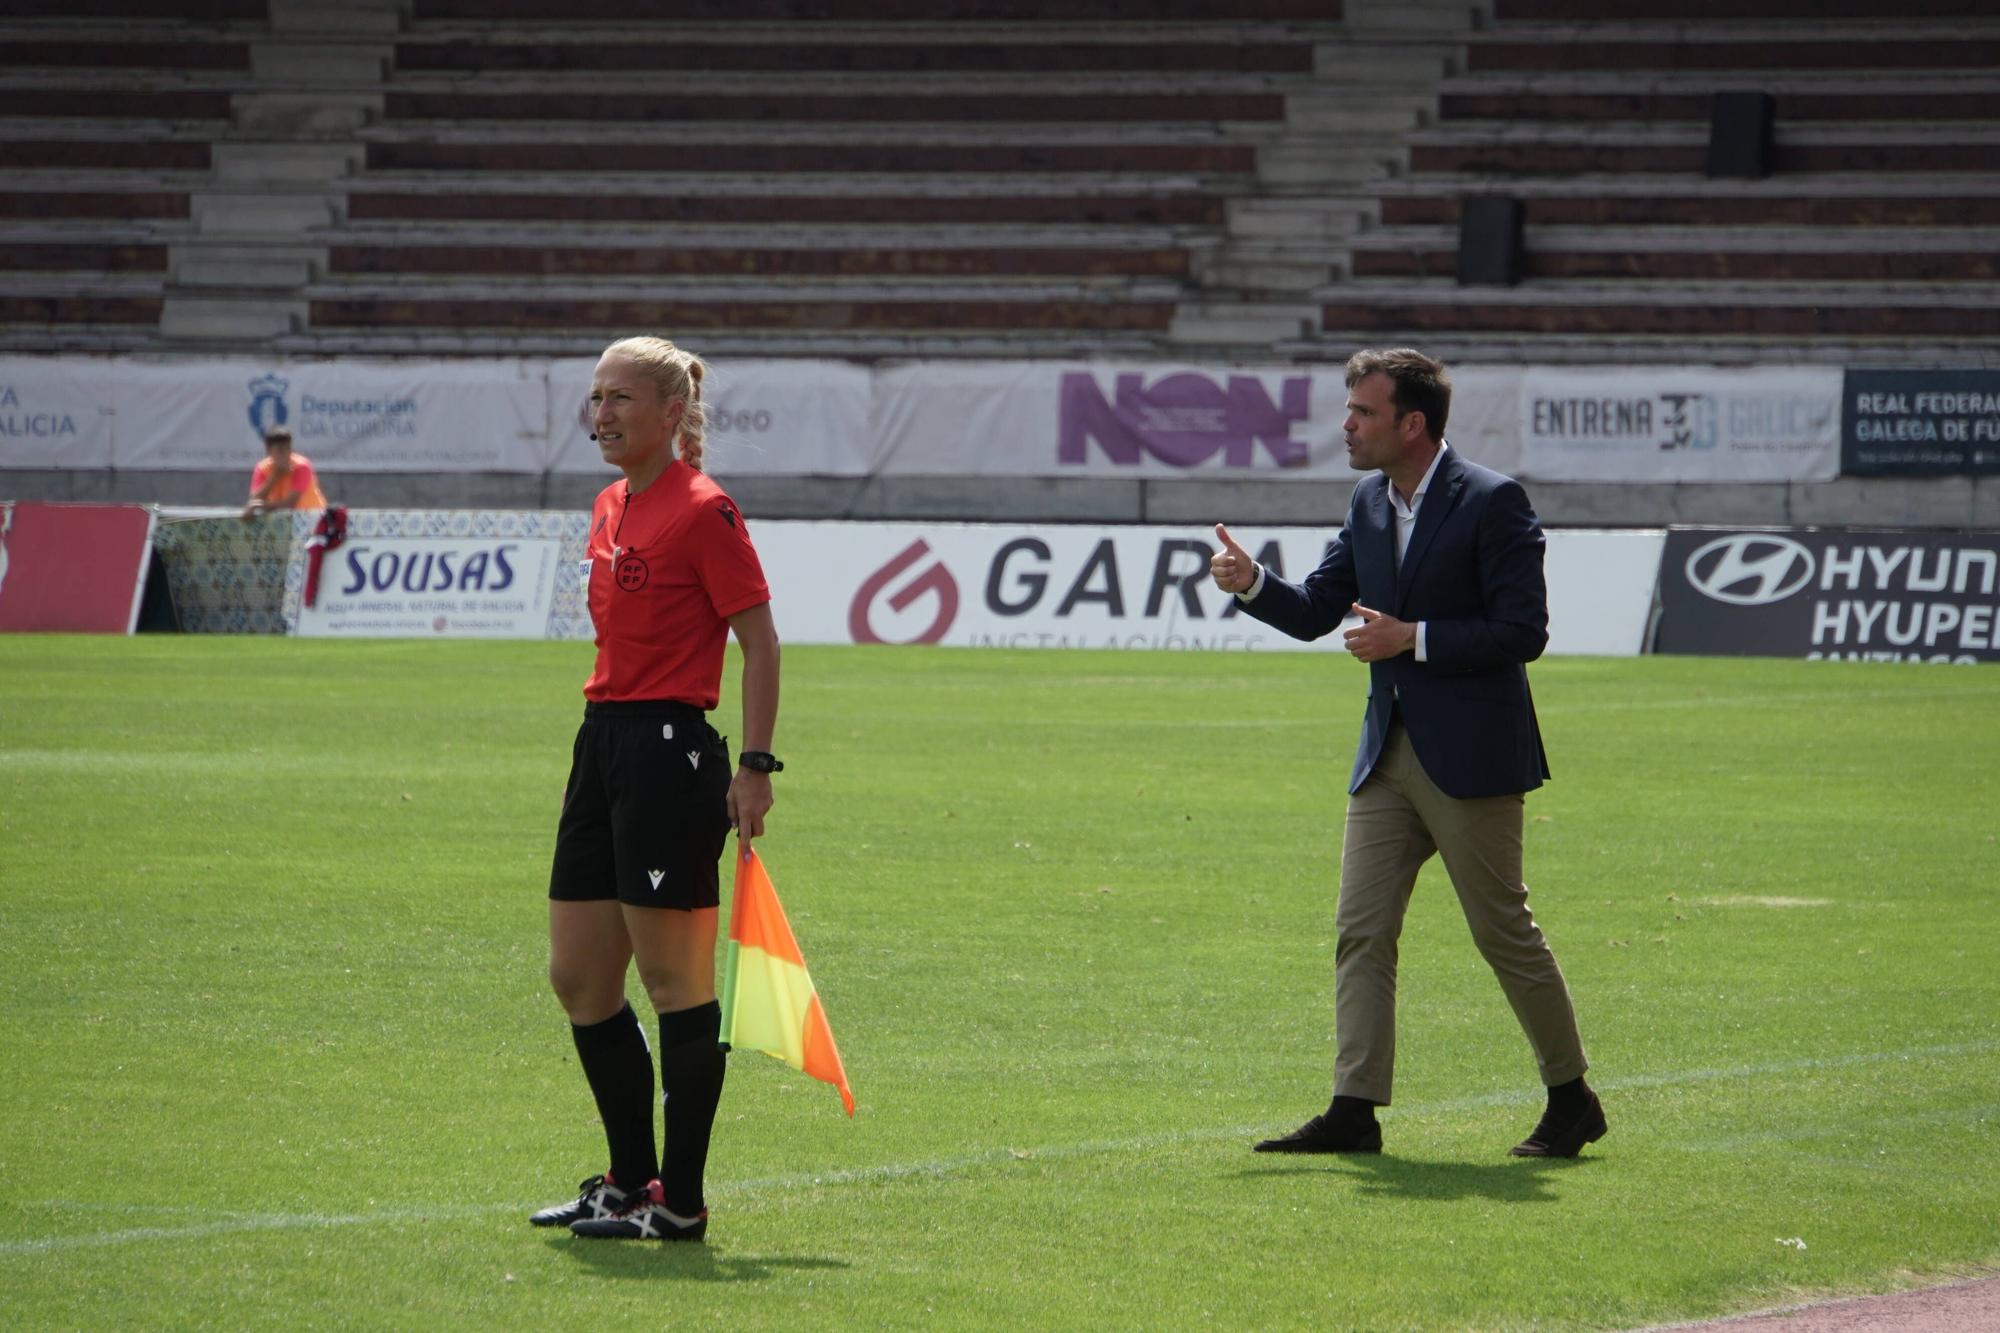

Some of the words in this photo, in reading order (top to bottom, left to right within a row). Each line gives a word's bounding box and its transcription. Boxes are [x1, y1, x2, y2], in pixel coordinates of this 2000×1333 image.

[1533, 398, 1653, 437] ENTRENA
[1857, 392, 1911, 414] REAL
[1856, 419, 1938, 441] GALEGA
[1942, 419, 1969, 441] DE
[342, 544, 518, 595] SOUSAS
[1811, 600, 2000, 650] HYUPE
